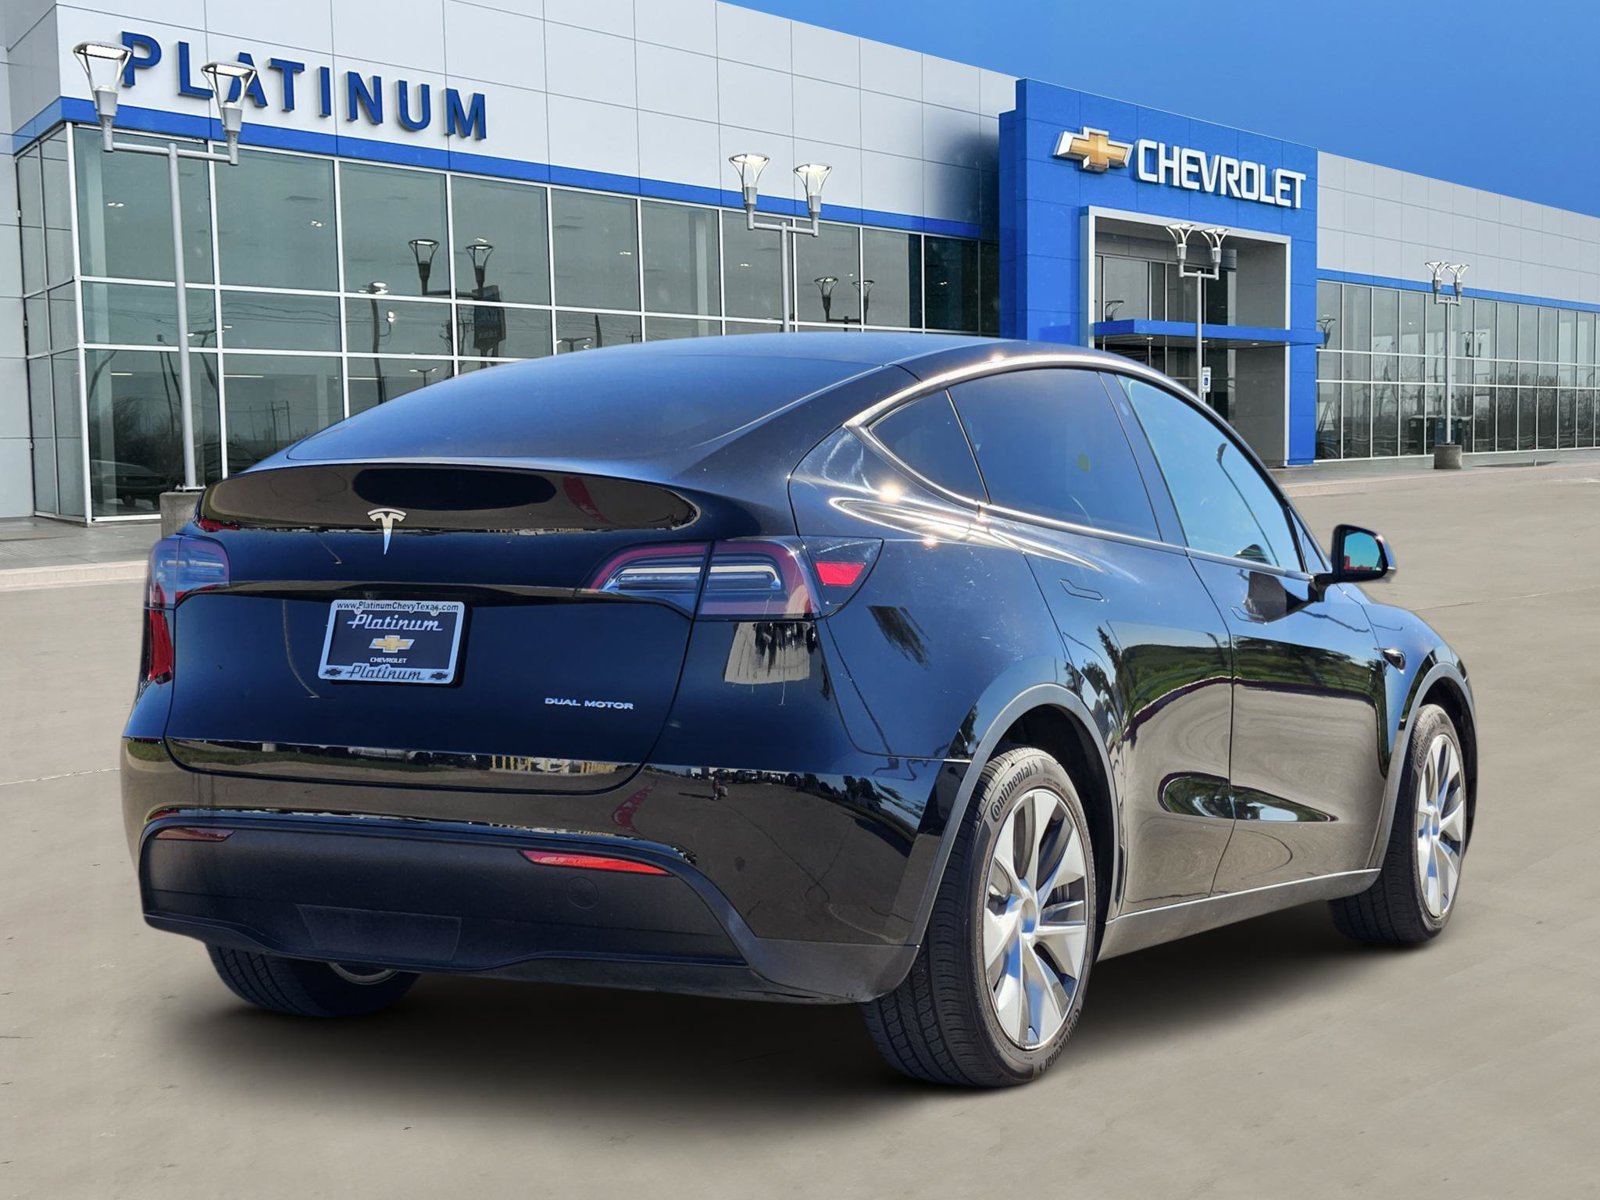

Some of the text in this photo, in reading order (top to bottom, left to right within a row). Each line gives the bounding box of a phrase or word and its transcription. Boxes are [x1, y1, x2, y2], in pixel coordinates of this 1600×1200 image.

[119, 31, 488, 142] PLATINUM
[1136, 138, 1306, 209] CHEVROLET
[347, 614, 443, 632] Platinum
[345, 664, 425, 681] Platinum
[545, 698, 634, 710] DUAL MOTOR
